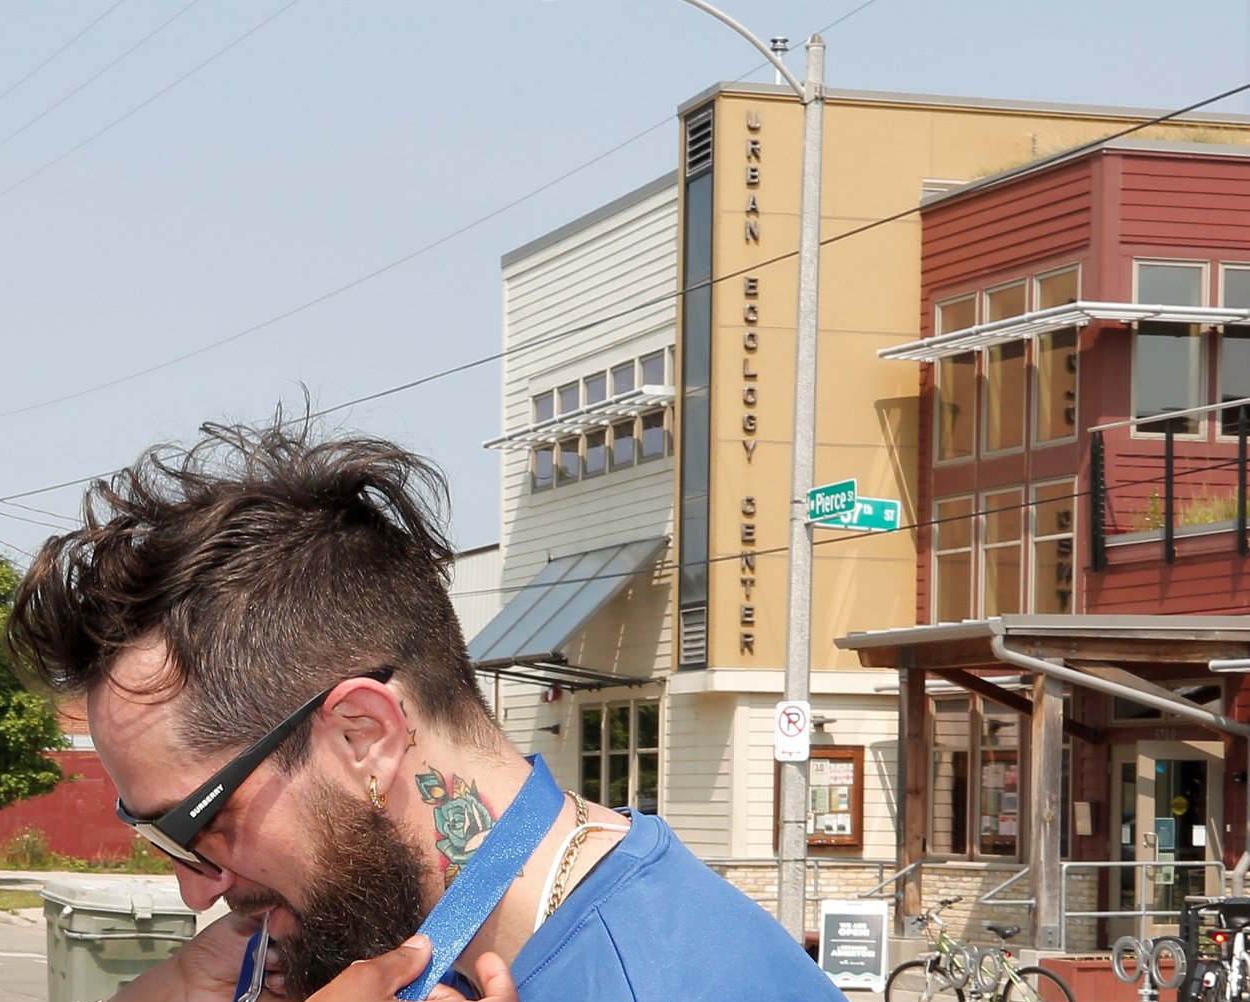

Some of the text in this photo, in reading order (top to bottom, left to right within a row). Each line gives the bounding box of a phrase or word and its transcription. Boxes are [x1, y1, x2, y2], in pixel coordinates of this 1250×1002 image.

[740, 111, 762, 656] URBAN ECOLOGY CENTER
[816, 492, 847, 514] Pierce
